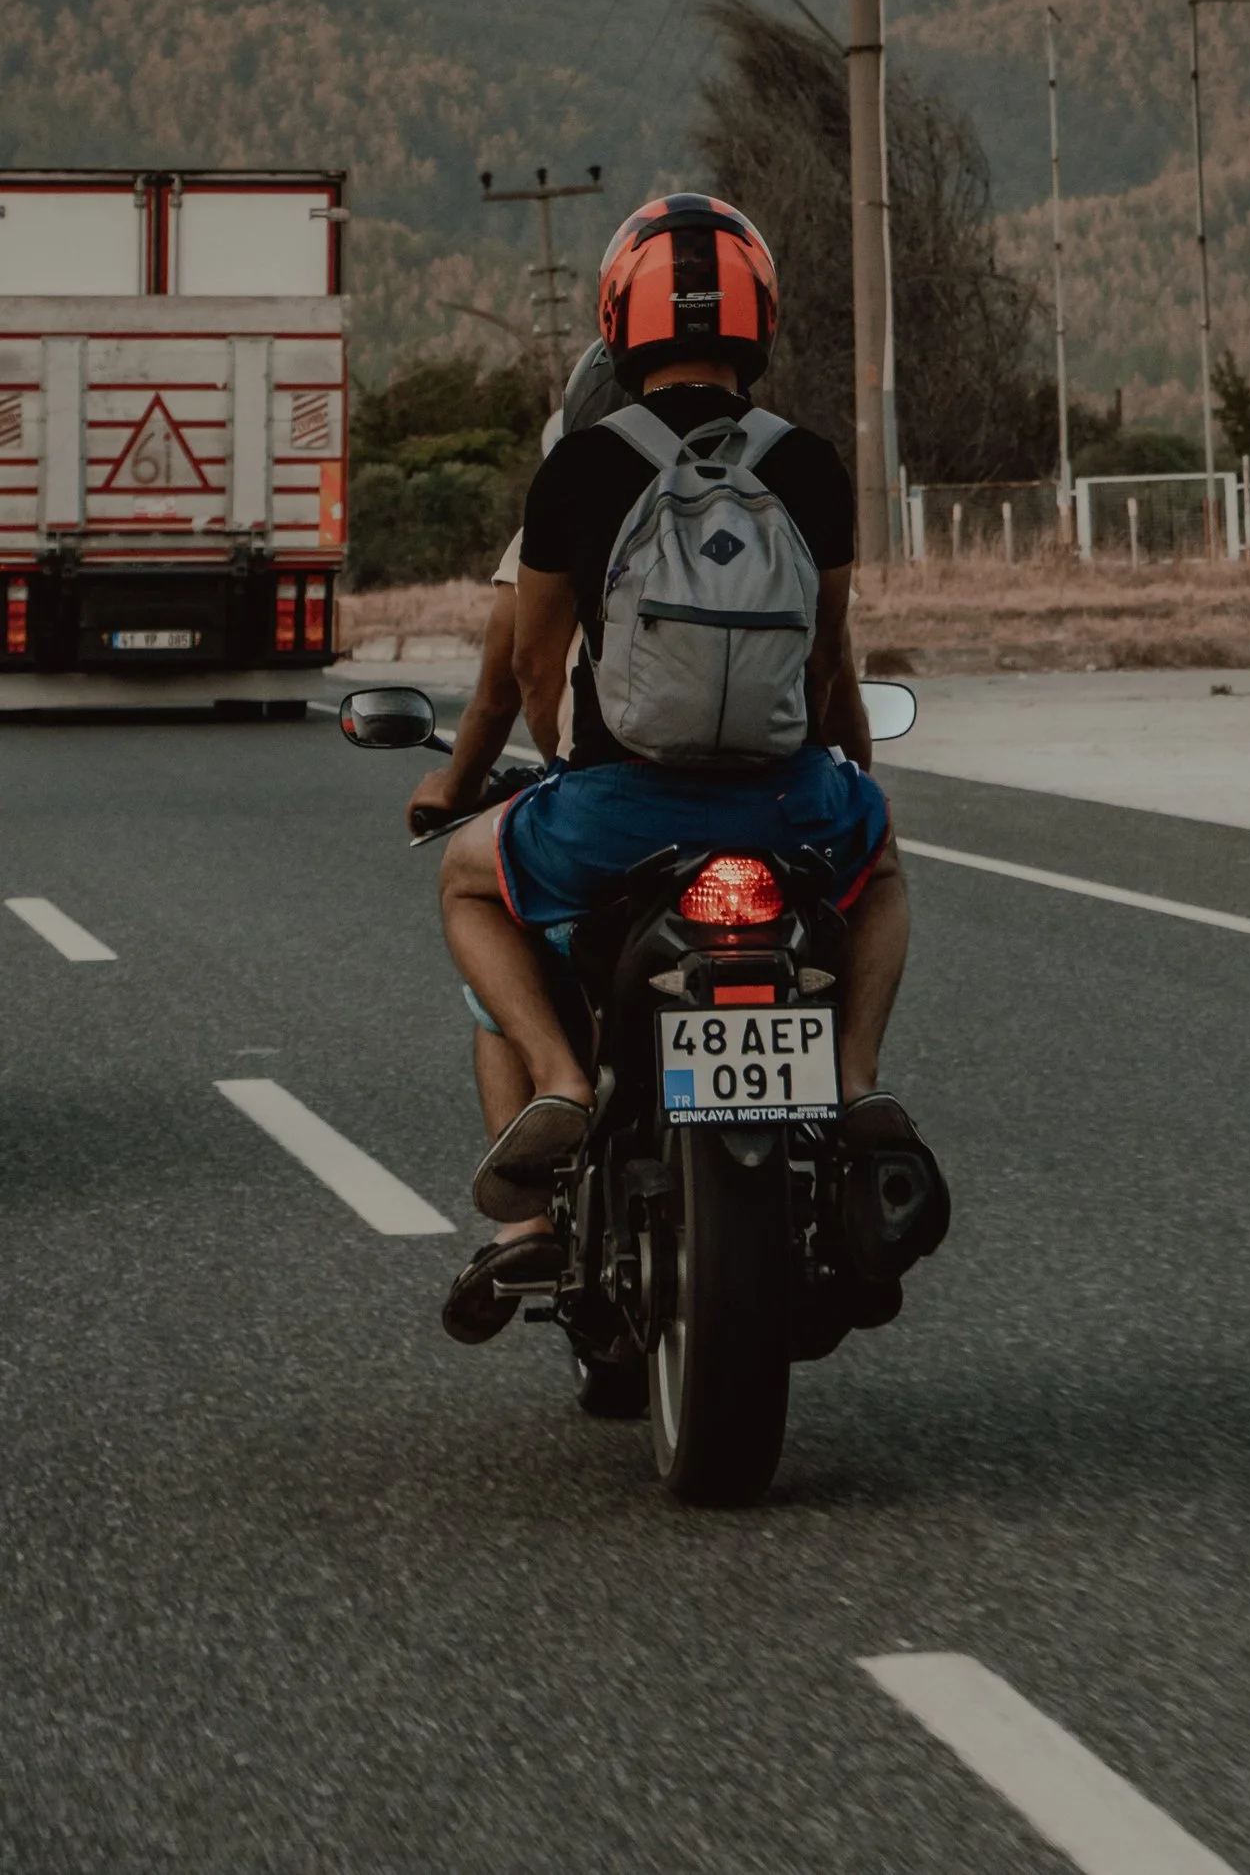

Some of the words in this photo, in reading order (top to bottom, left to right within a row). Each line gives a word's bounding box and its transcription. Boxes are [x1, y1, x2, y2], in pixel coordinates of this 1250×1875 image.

[669, 291, 726, 301] LS2
[672, 1018, 727, 1056] 48
[741, 1017, 823, 1055] AEP
[712, 1062, 792, 1101] 091
[673, 1095, 691, 1107] TR
[669, 1108, 734, 1123] CENKAYA
[737, 1107, 788, 1121] MOTOR
